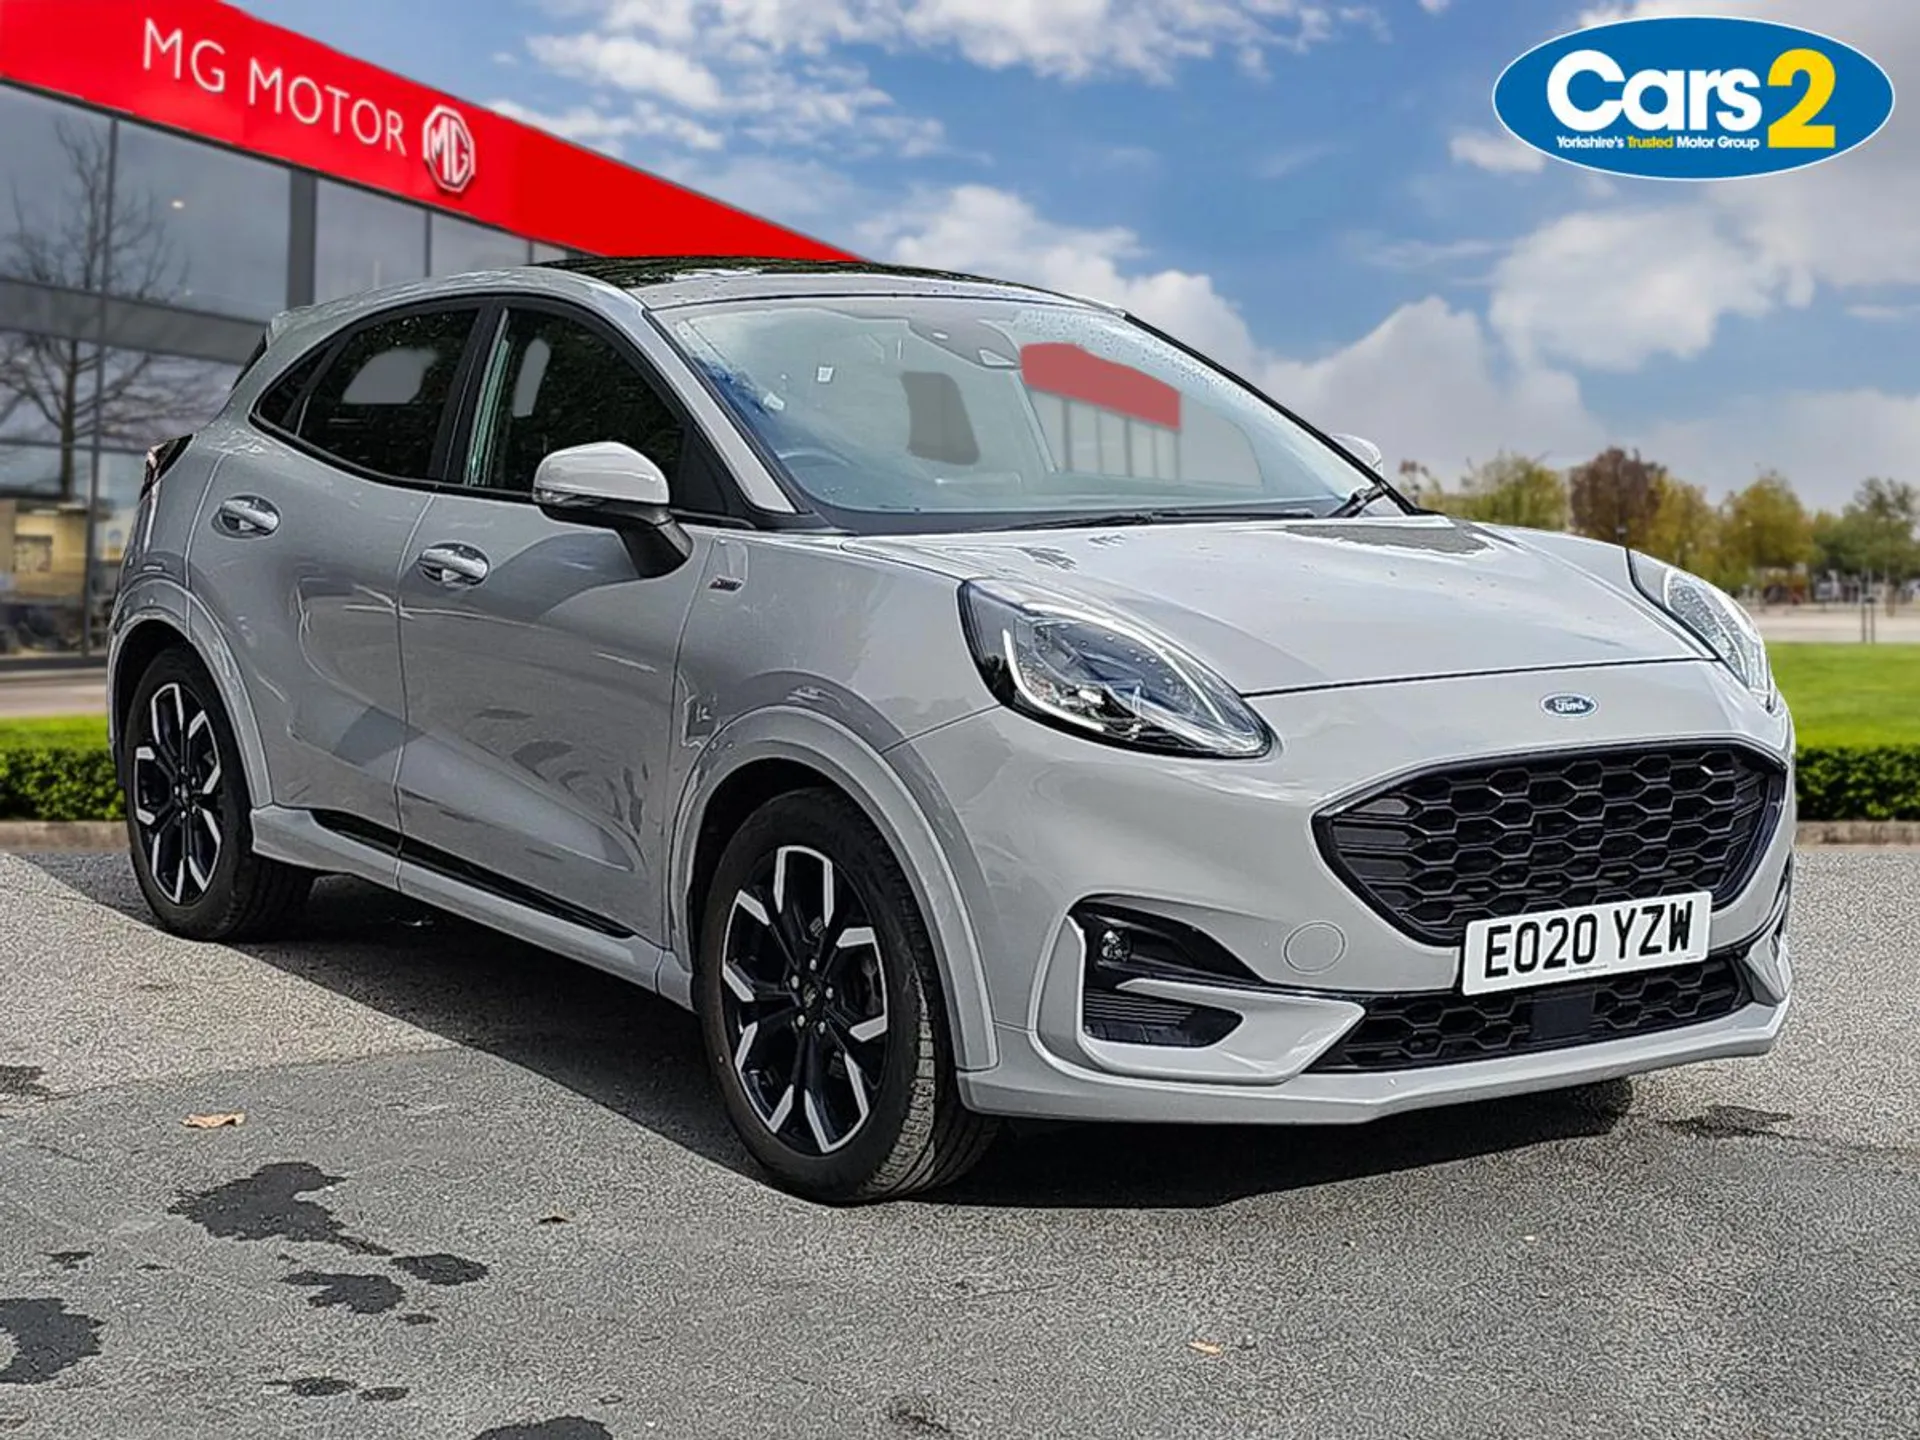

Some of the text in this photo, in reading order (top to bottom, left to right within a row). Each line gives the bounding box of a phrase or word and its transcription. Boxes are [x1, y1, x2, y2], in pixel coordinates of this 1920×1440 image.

[143, 18, 407, 156] MG MOTOR
[426, 115, 473, 187] MG
[1613, 900, 1694, 960] YZW
